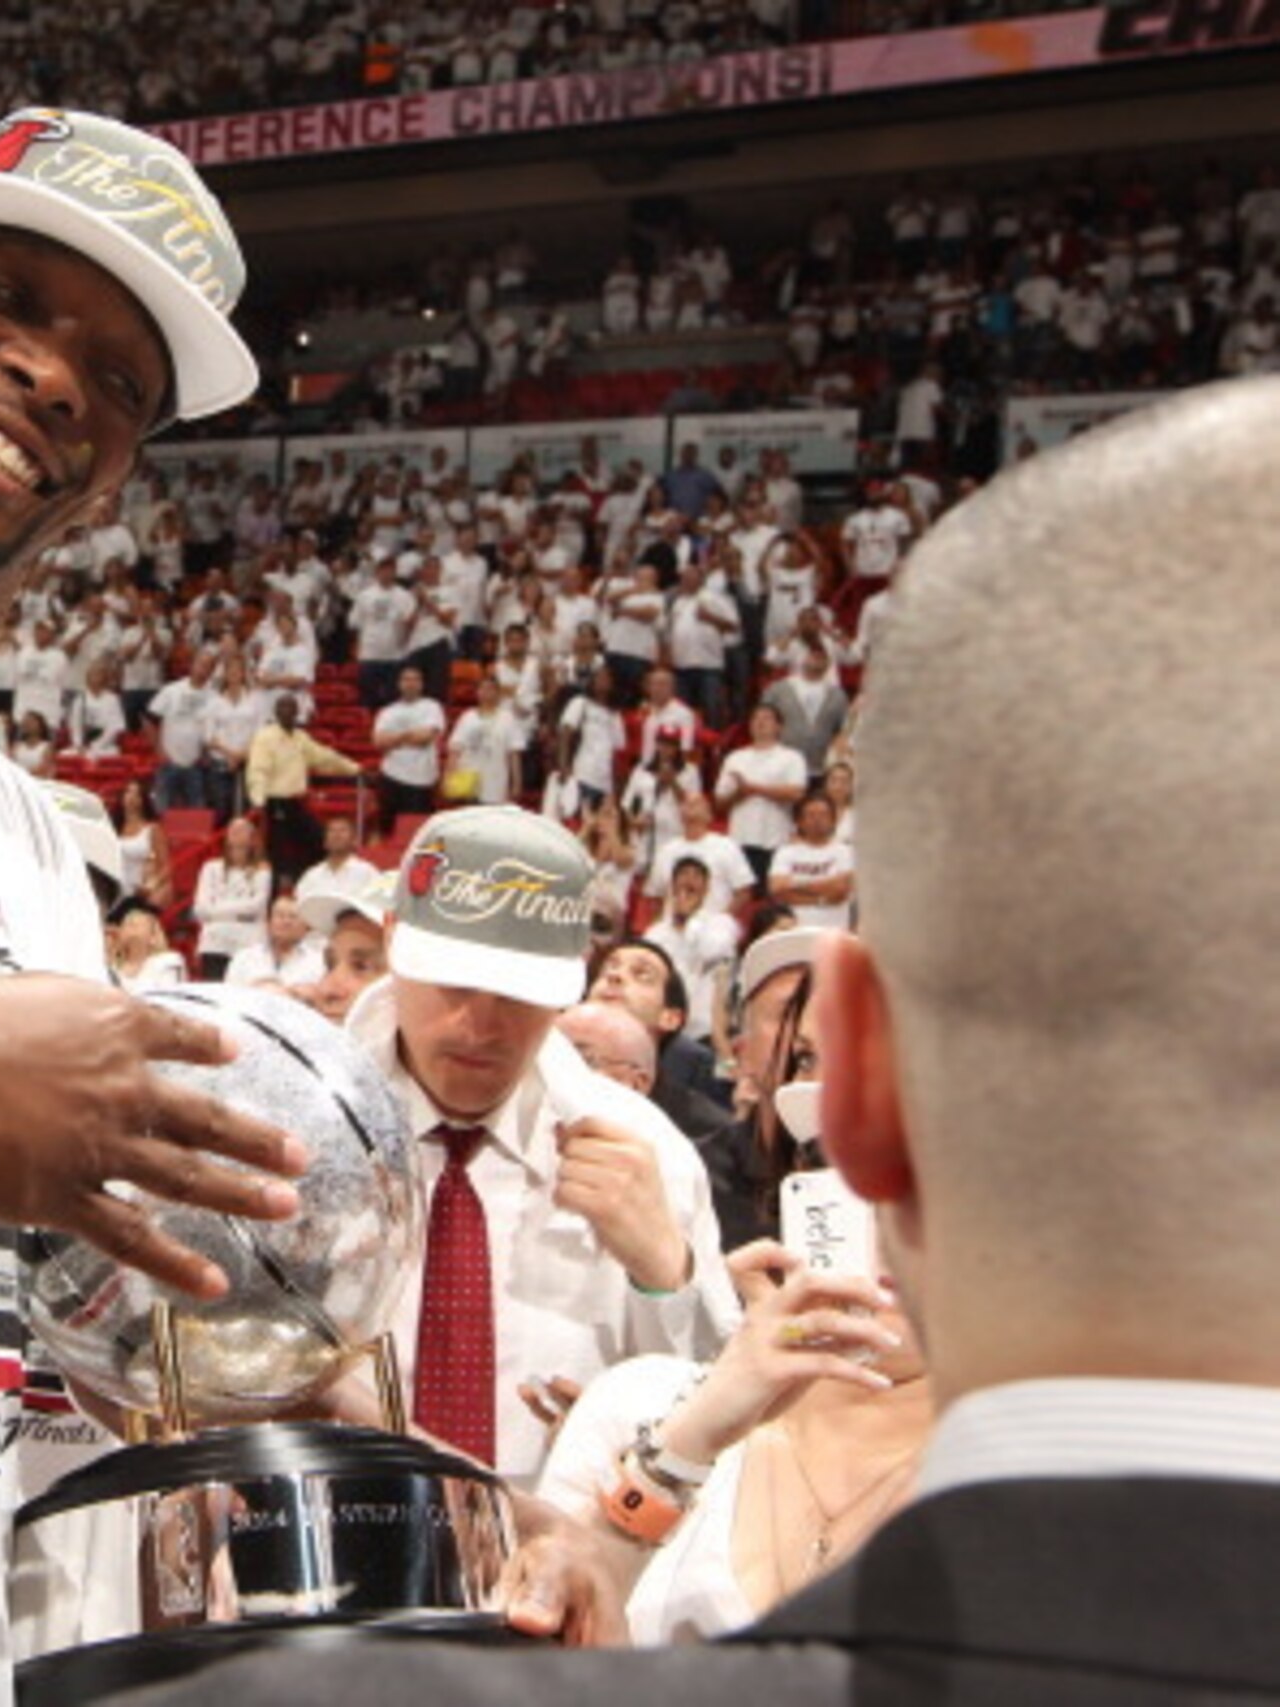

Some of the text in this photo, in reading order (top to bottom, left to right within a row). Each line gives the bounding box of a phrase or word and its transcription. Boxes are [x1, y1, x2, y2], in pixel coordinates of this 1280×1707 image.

[153, 96, 424, 163] NFERENCE
[33, 141, 139, 208] The
[433, 857, 592, 925] The Final
